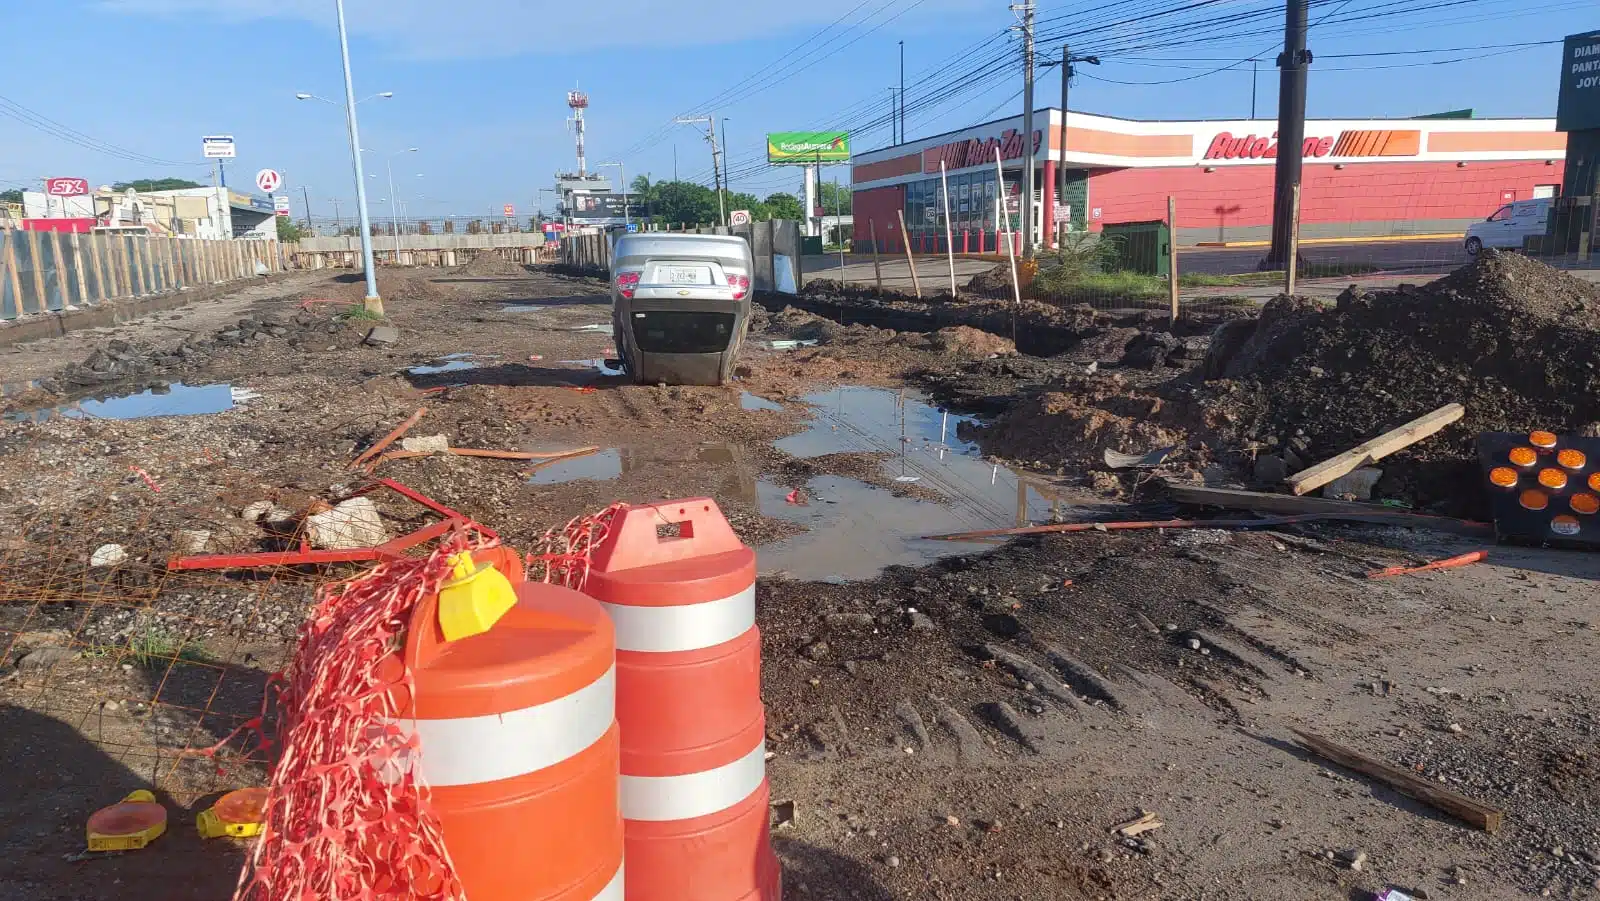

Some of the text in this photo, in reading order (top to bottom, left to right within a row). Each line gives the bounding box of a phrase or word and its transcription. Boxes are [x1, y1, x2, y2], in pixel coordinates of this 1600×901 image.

[1571, 60, 1600, 74] PANT
[1576, 76, 1600, 89] JOY
[1203, 131, 1334, 160] Autone
